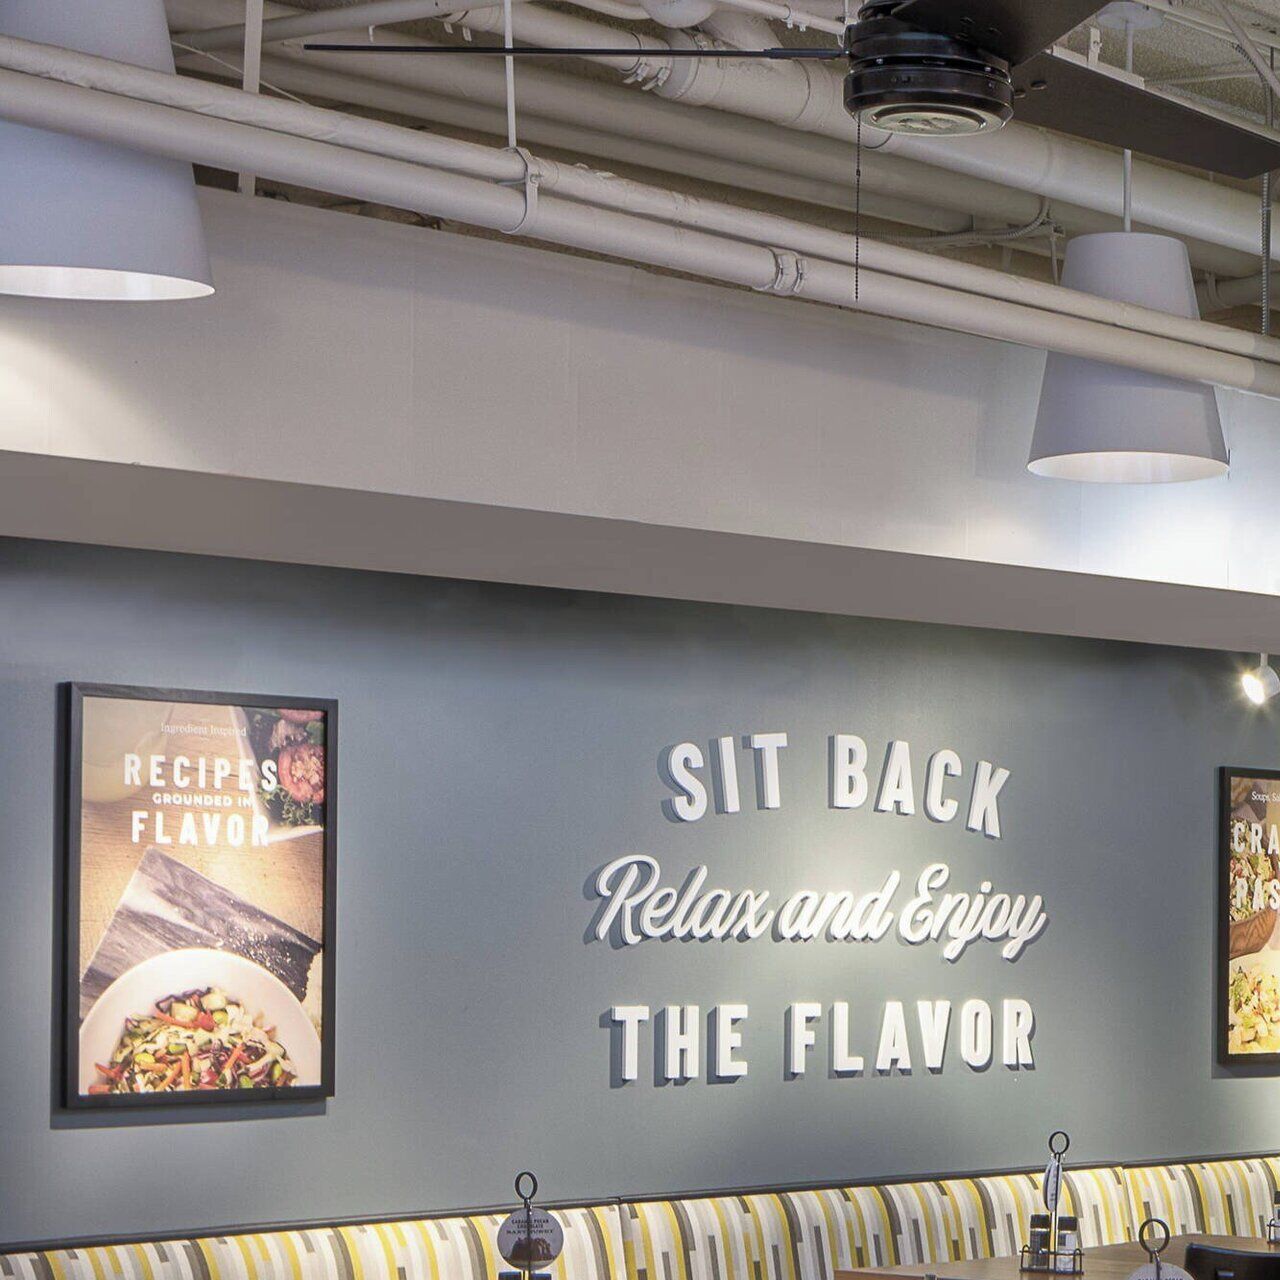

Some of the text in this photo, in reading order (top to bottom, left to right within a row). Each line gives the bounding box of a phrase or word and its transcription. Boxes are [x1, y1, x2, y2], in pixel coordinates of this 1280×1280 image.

[160, 722, 207, 735] Ingredient
[123, 753, 278, 792] RECIPES
[669, 732, 1011, 839] SIT BACK
[152, 793, 256, 808] GROUNDED IN
[131, 811, 270, 847] FLAVOR
[596, 854, 1048, 961] Relax and Enjoy
[611, 998, 1035, 1081] THE FLAVOR
